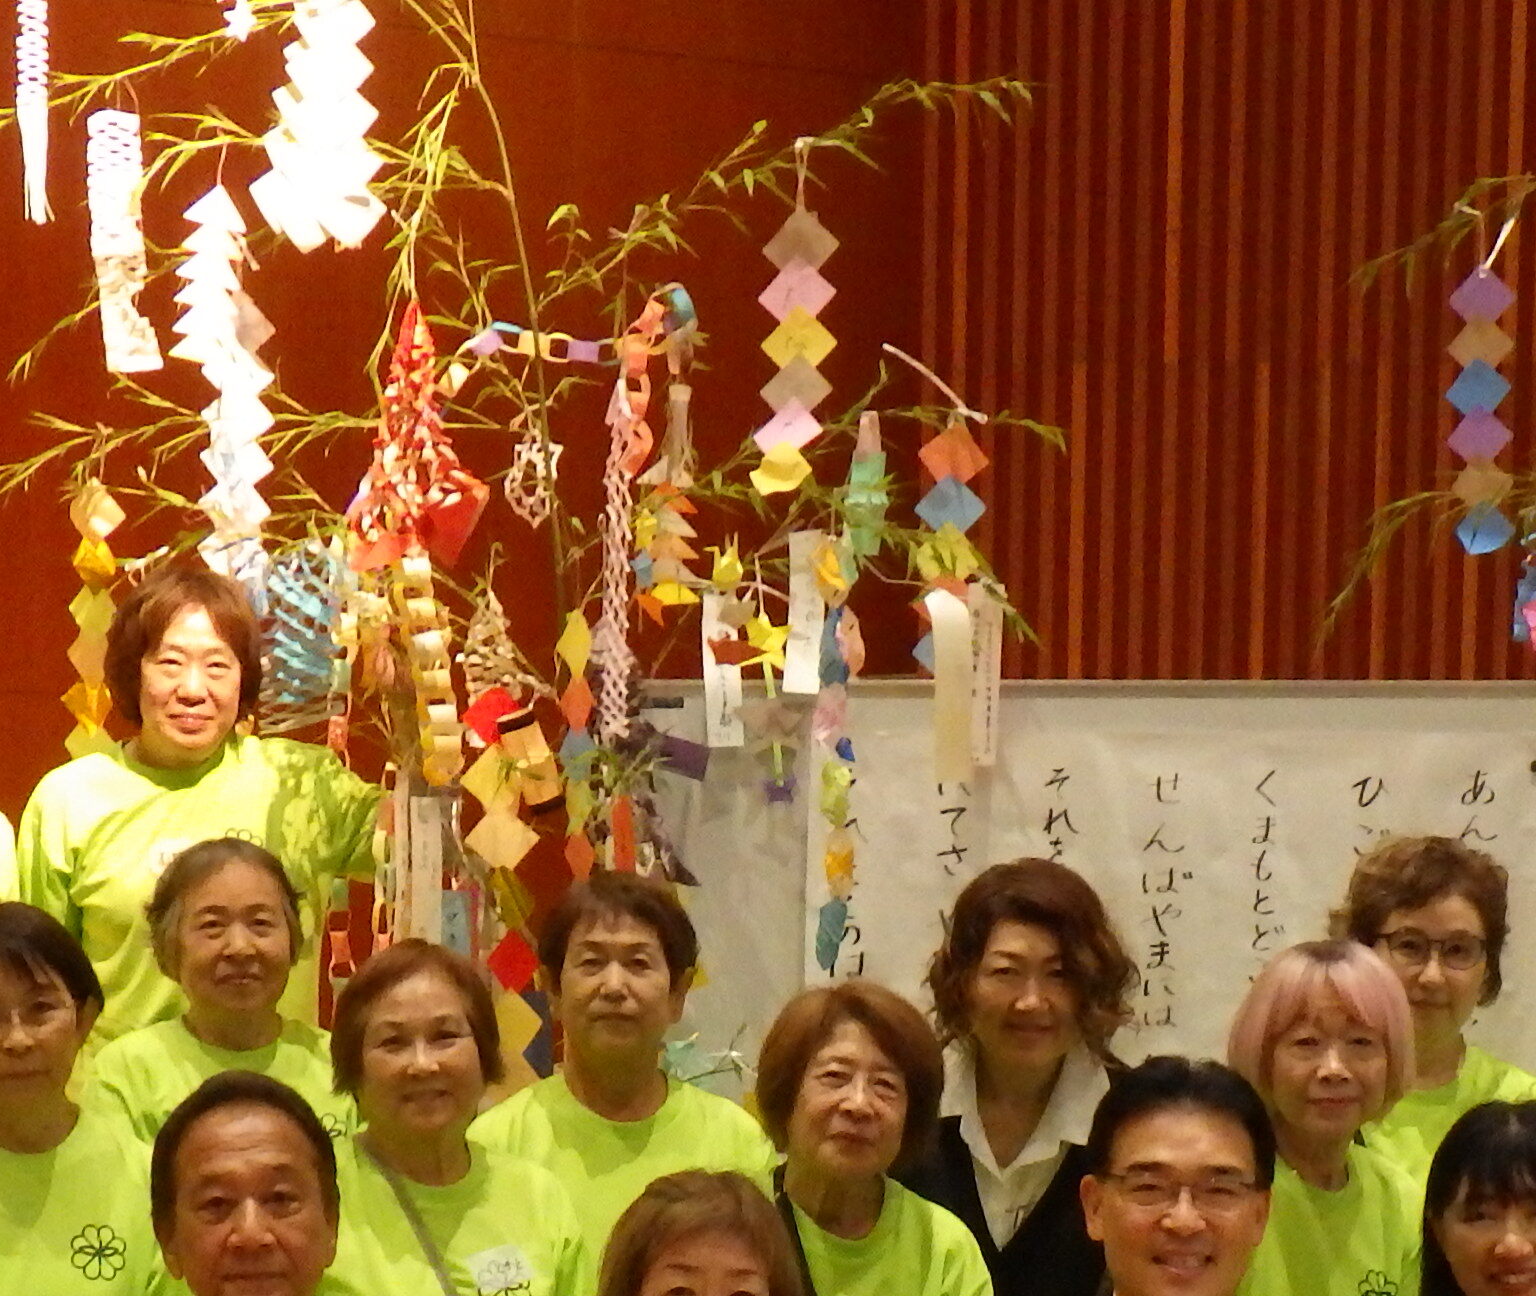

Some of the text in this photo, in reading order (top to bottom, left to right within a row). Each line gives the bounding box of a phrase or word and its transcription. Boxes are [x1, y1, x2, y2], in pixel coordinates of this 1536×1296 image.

[1135, 772, 1194, 1030] せんばやまには
[1247, 769, 1287, 983] くまもとど
